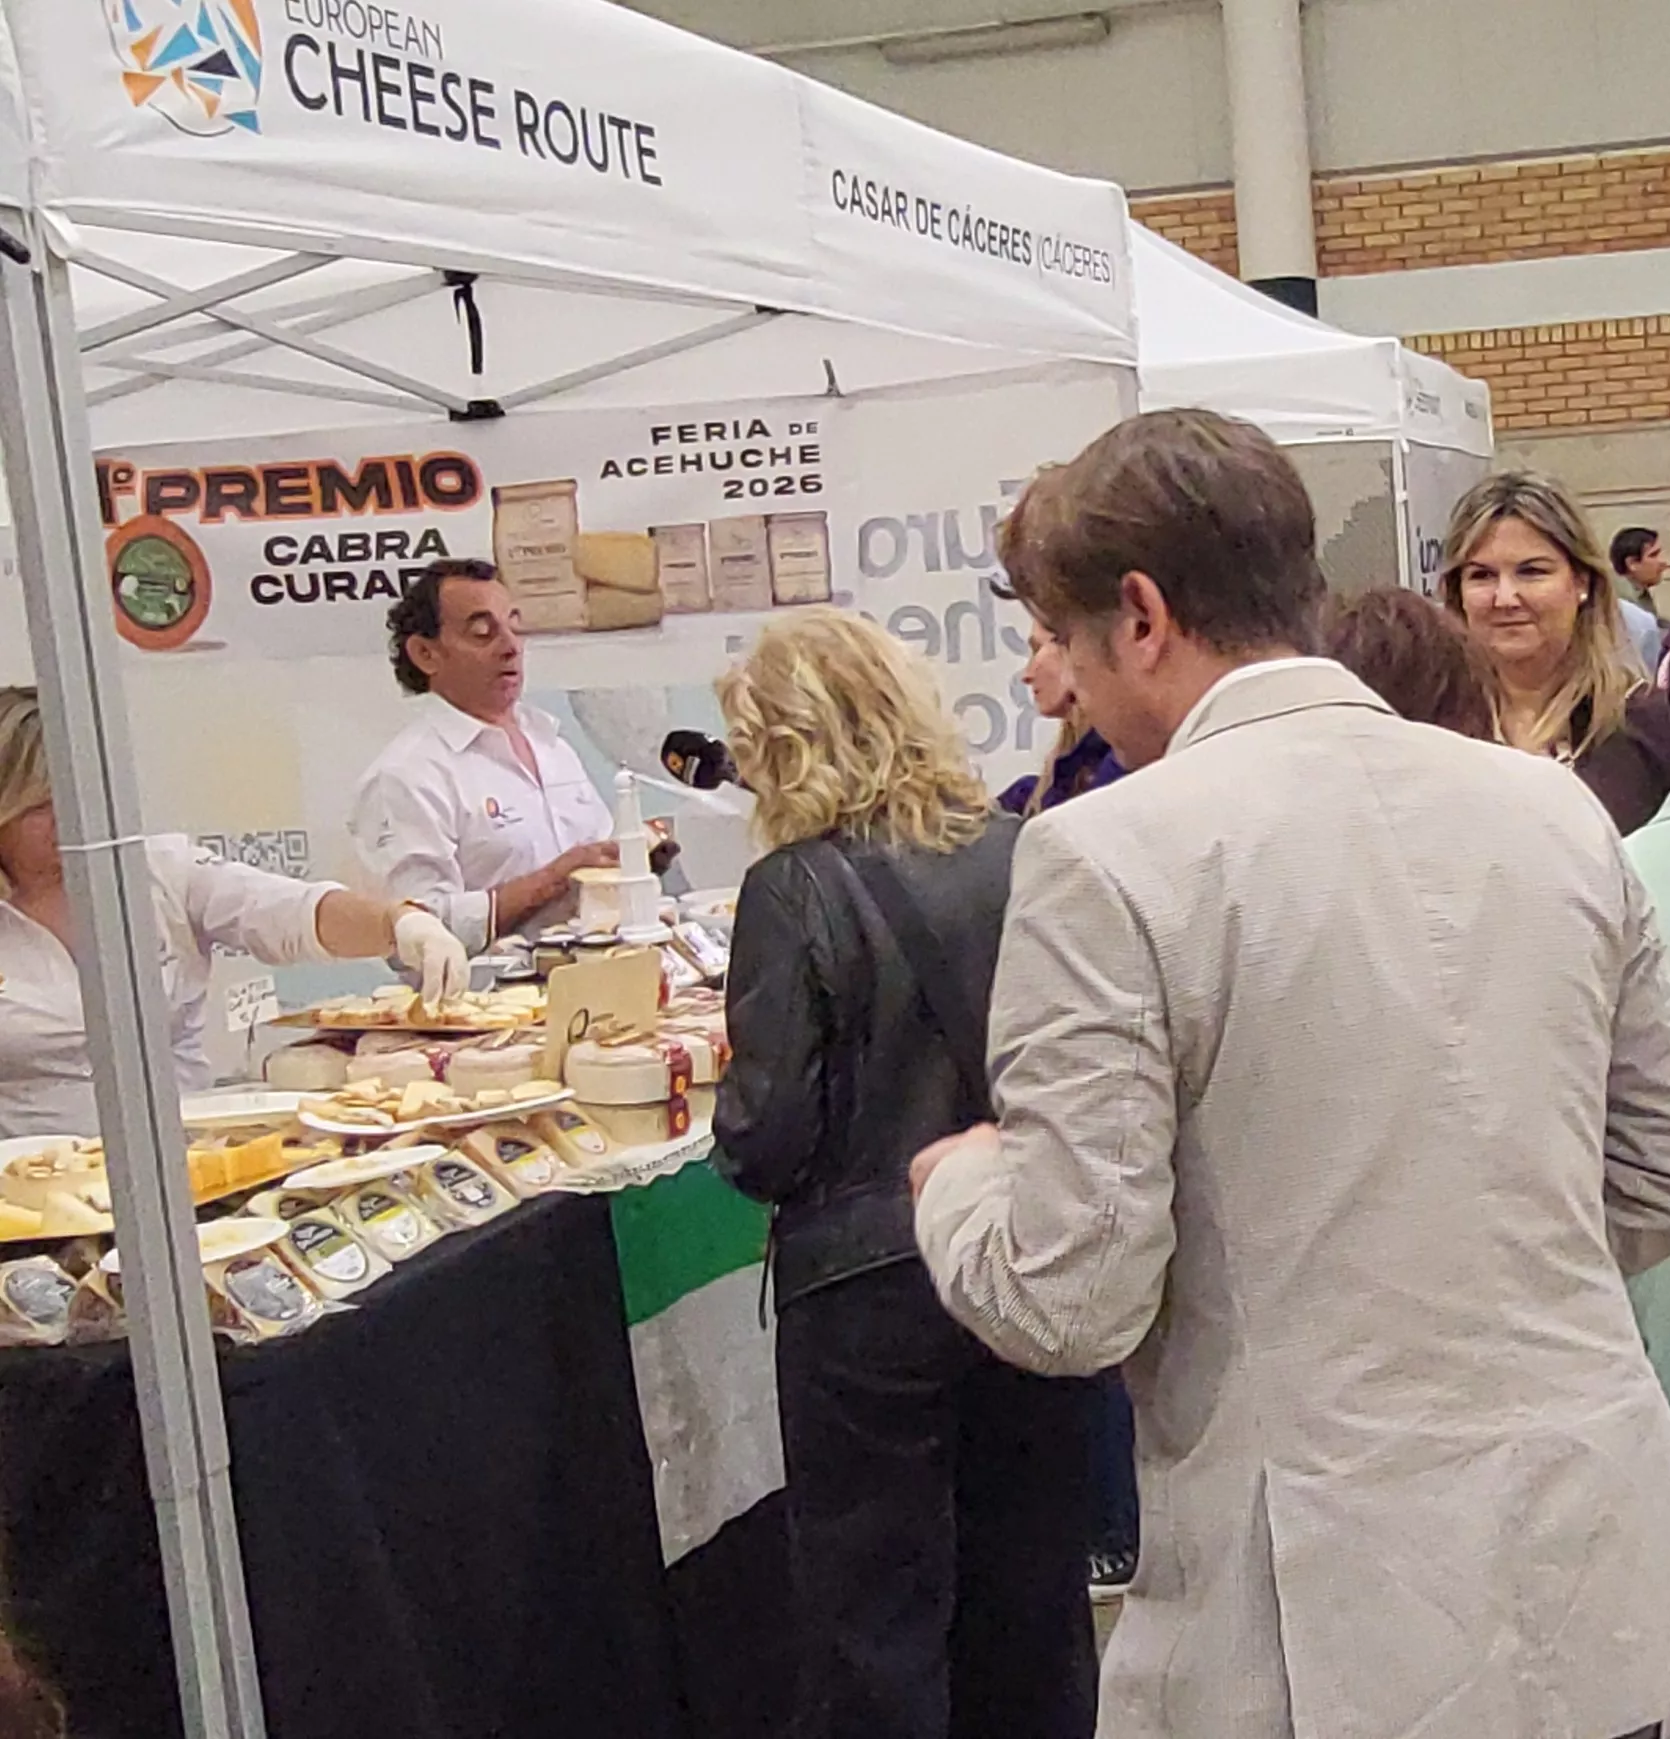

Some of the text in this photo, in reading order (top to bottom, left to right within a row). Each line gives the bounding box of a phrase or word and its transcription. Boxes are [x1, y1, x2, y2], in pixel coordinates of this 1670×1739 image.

[284, 34, 662, 187] CHEESE ROUTE
[831, 169, 911, 232] CASAR
[915, 197, 943, 240] DE
[948, 204, 1032, 266] CÁCERES
[651, 419, 819, 446] FERIA DE
[600, 444, 821, 480] ACEHUCHE
[144, 454, 481, 521] PREMIO
[722, 473, 823, 500] 2026
[264, 527, 451, 566] CABRA
[250, 567, 415, 605] CURA
